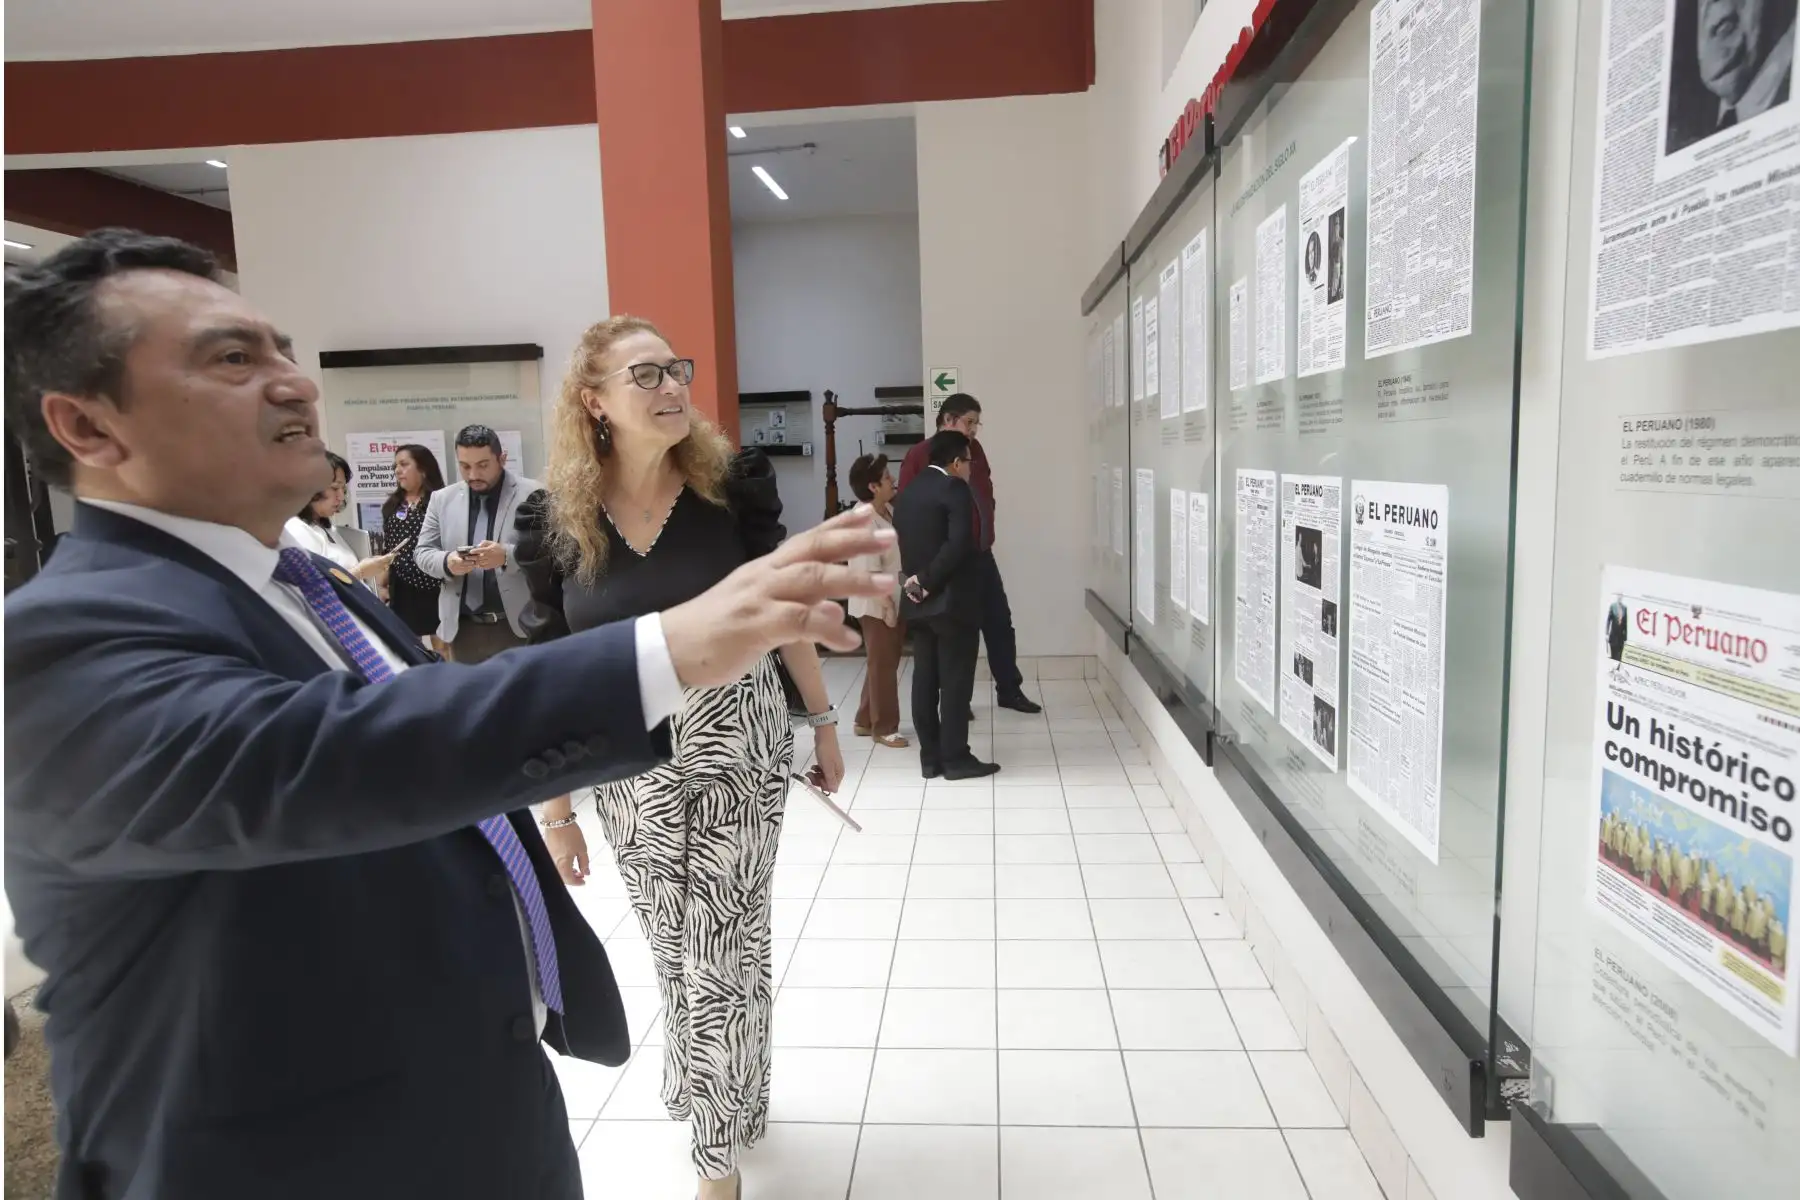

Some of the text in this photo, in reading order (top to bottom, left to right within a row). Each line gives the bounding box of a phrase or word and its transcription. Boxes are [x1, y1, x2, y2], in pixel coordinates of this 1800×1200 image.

[1623, 421, 1633, 432] EL
[1636, 418, 1683, 431] PERUANO
[369, 443, 378, 452] El
[1621, 438, 1631, 449] La
[1680, 435, 1693, 448] del
[1688, 455, 1702, 466] de
[370, 472, 389, 480] Puno
[1665, 472, 1676, 484] de
[1301, 483, 1323, 498] PERUANO
[1369, 501, 1438, 530] EL PERUANO
[1636, 607, 1658, 638] El
[1664, 612, 1768, 664] Peruano
[1607, 700, 1640, 739] Un
[1650, 717, 1795, 802] histórico
[1604, 740, 1792, 842] compromiso
